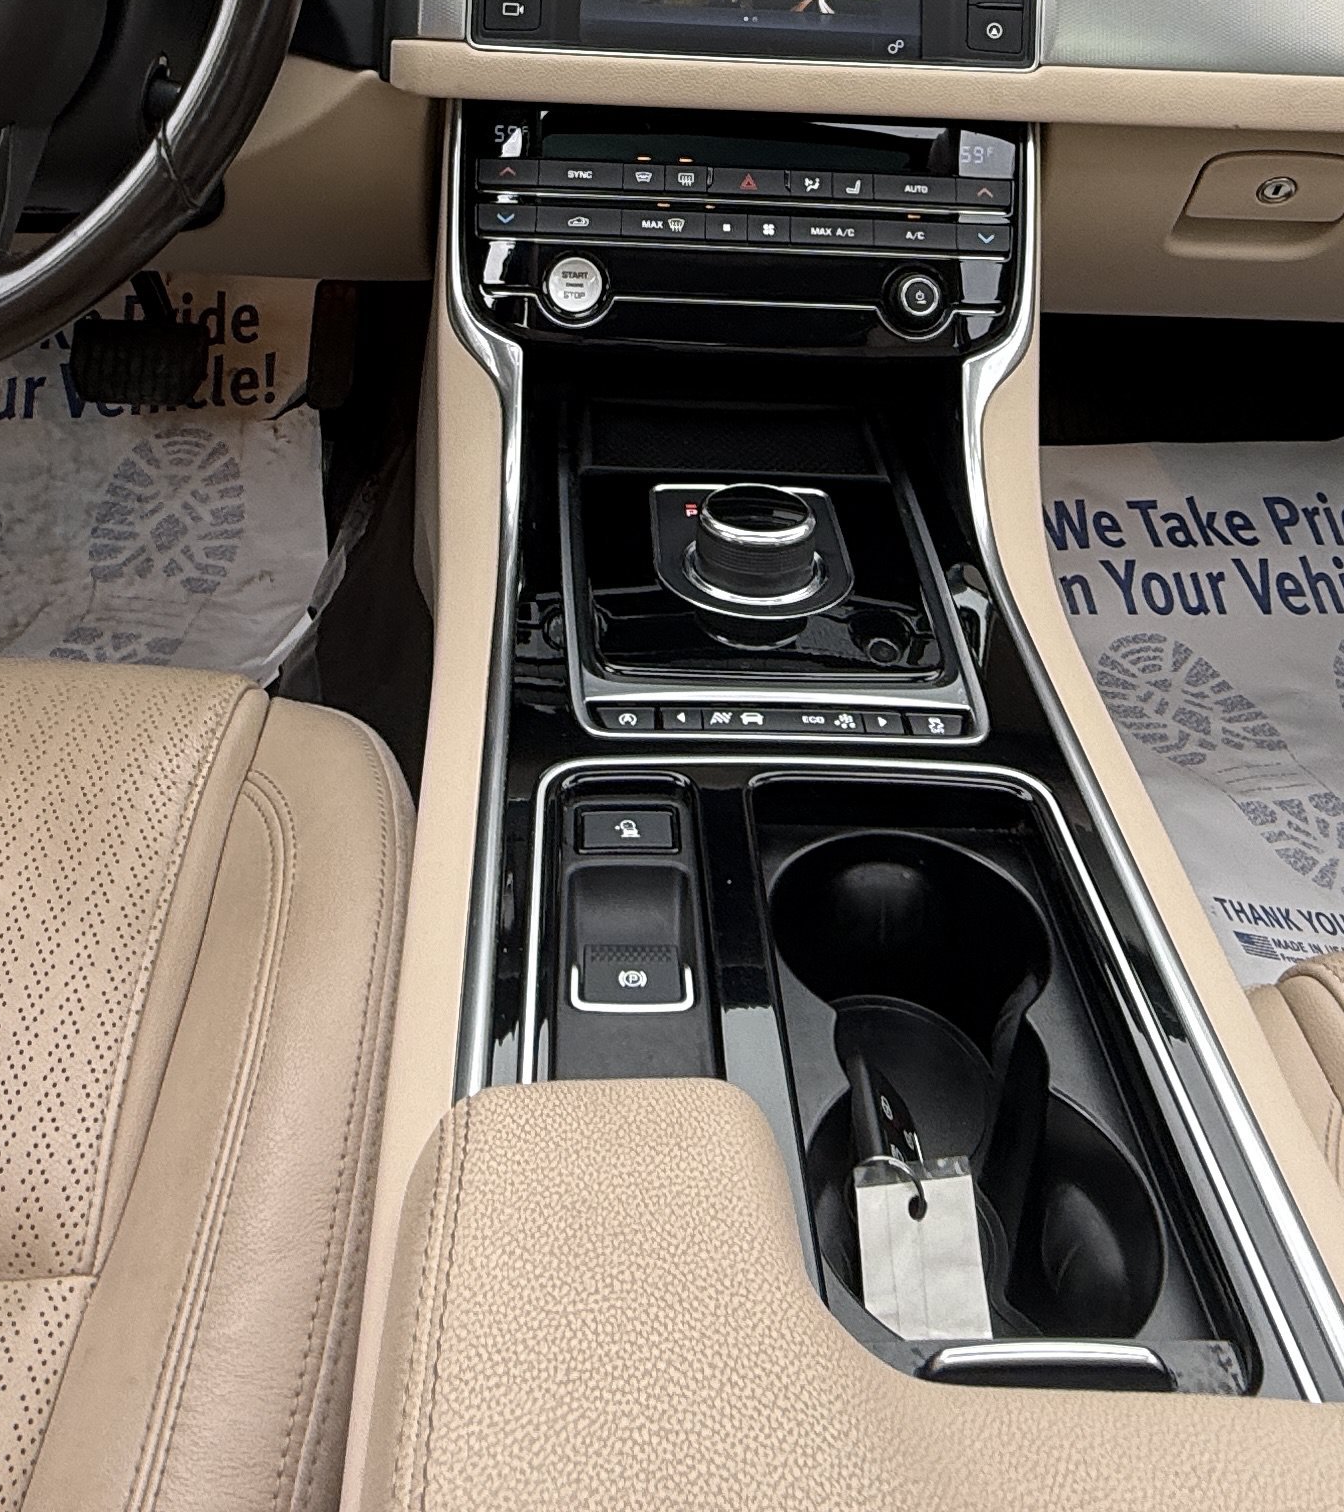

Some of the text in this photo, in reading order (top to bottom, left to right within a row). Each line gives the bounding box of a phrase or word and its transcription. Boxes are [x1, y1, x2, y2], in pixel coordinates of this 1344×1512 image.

[567, 170, 593, 179] SYNC
[904, 185, 929, 194] AUTO
[641, 219, 664, 229] MAX
[810, 227, 855, 237] MAX A/C
[905, 231, 926, 240] A/C
[561, 271, 588, 279] START
[563, 291, 586, 299] STOP
[1042, 498, 1127, 552] We
[1126, 495, 1261, 549] Take
[1059, 569, 1099, 616] n
[1098, 558, 1227, 616] Your
[801, 715, 825, 724] ECO
[1212, 896, 1304, 933] THANK
[1271, 938, 1308, 953] MADE
[1308, 943, 1324, 955] IN
